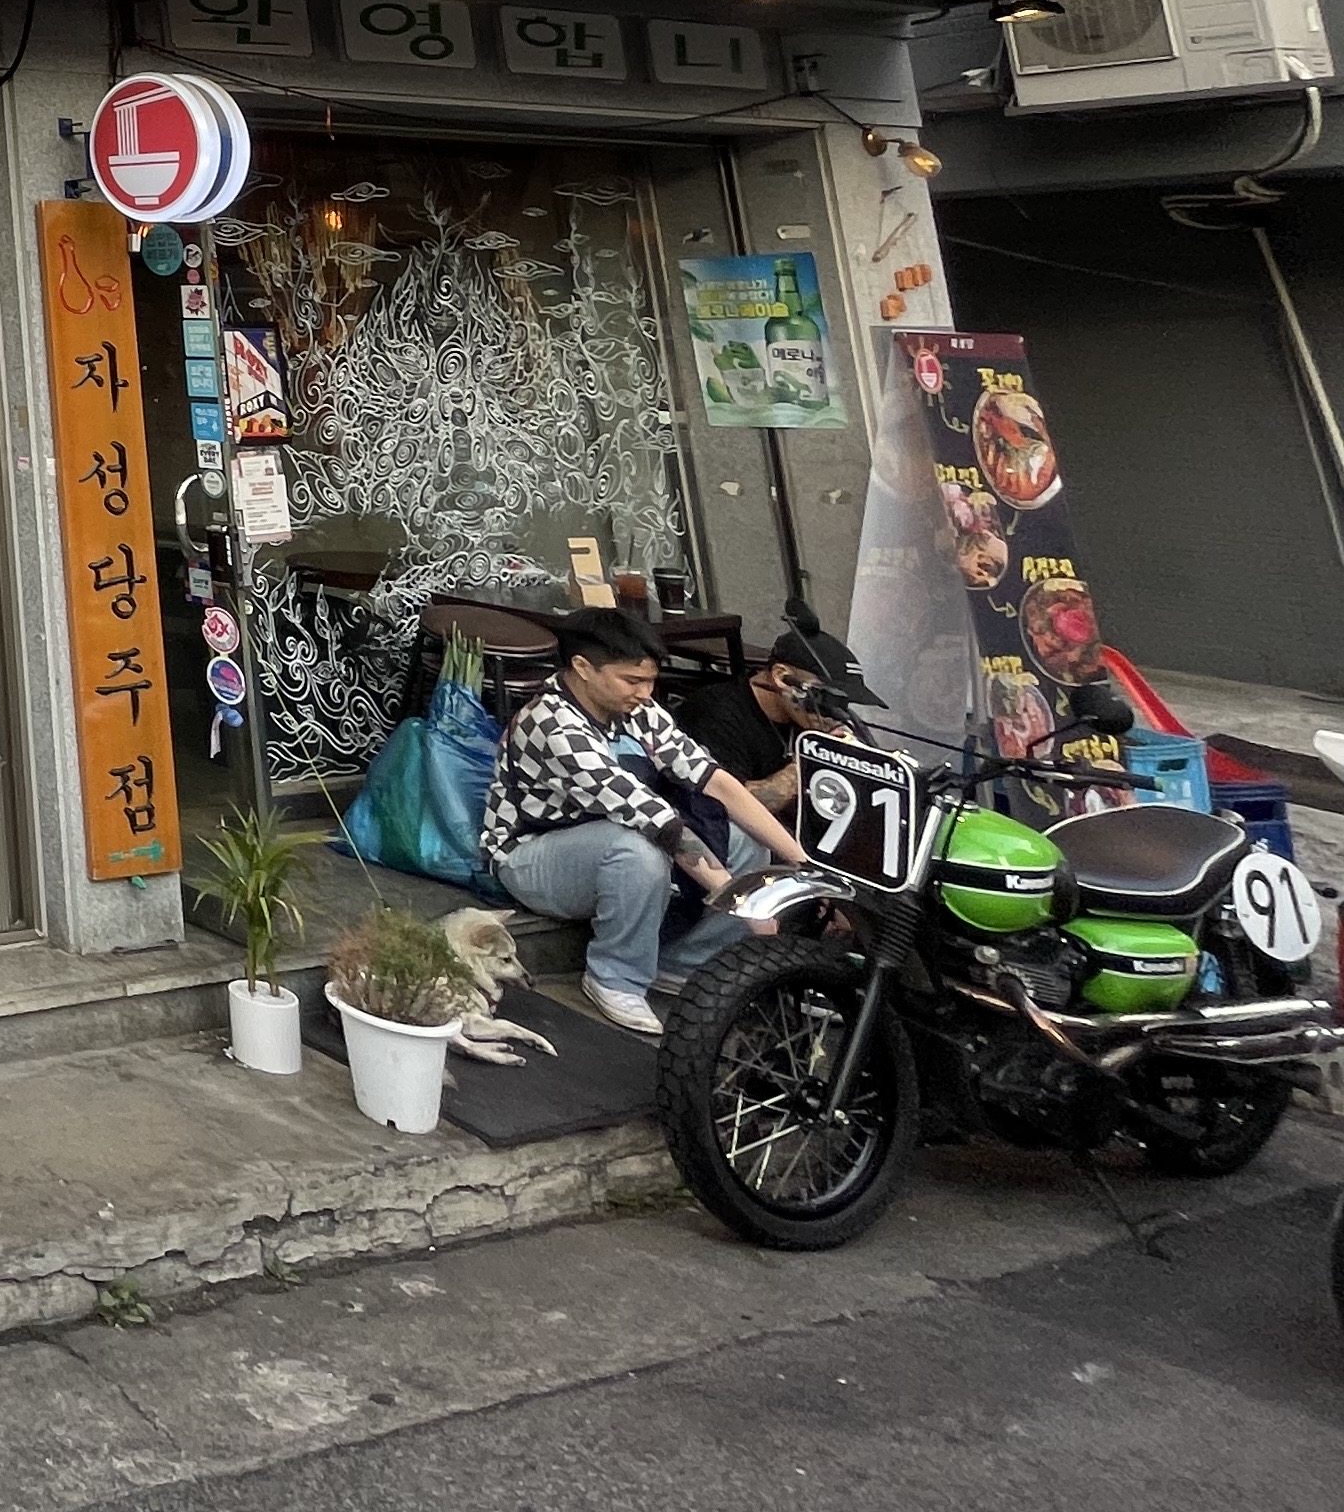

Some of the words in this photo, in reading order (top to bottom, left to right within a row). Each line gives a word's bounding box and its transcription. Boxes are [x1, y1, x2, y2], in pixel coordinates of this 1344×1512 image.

[71, 340, 157, 836] 자성당주점
[801, 738, 905, 785] Kawasaki
[809, 768, 901, 879] 91
[1245, 867, 1310, 949] 91
